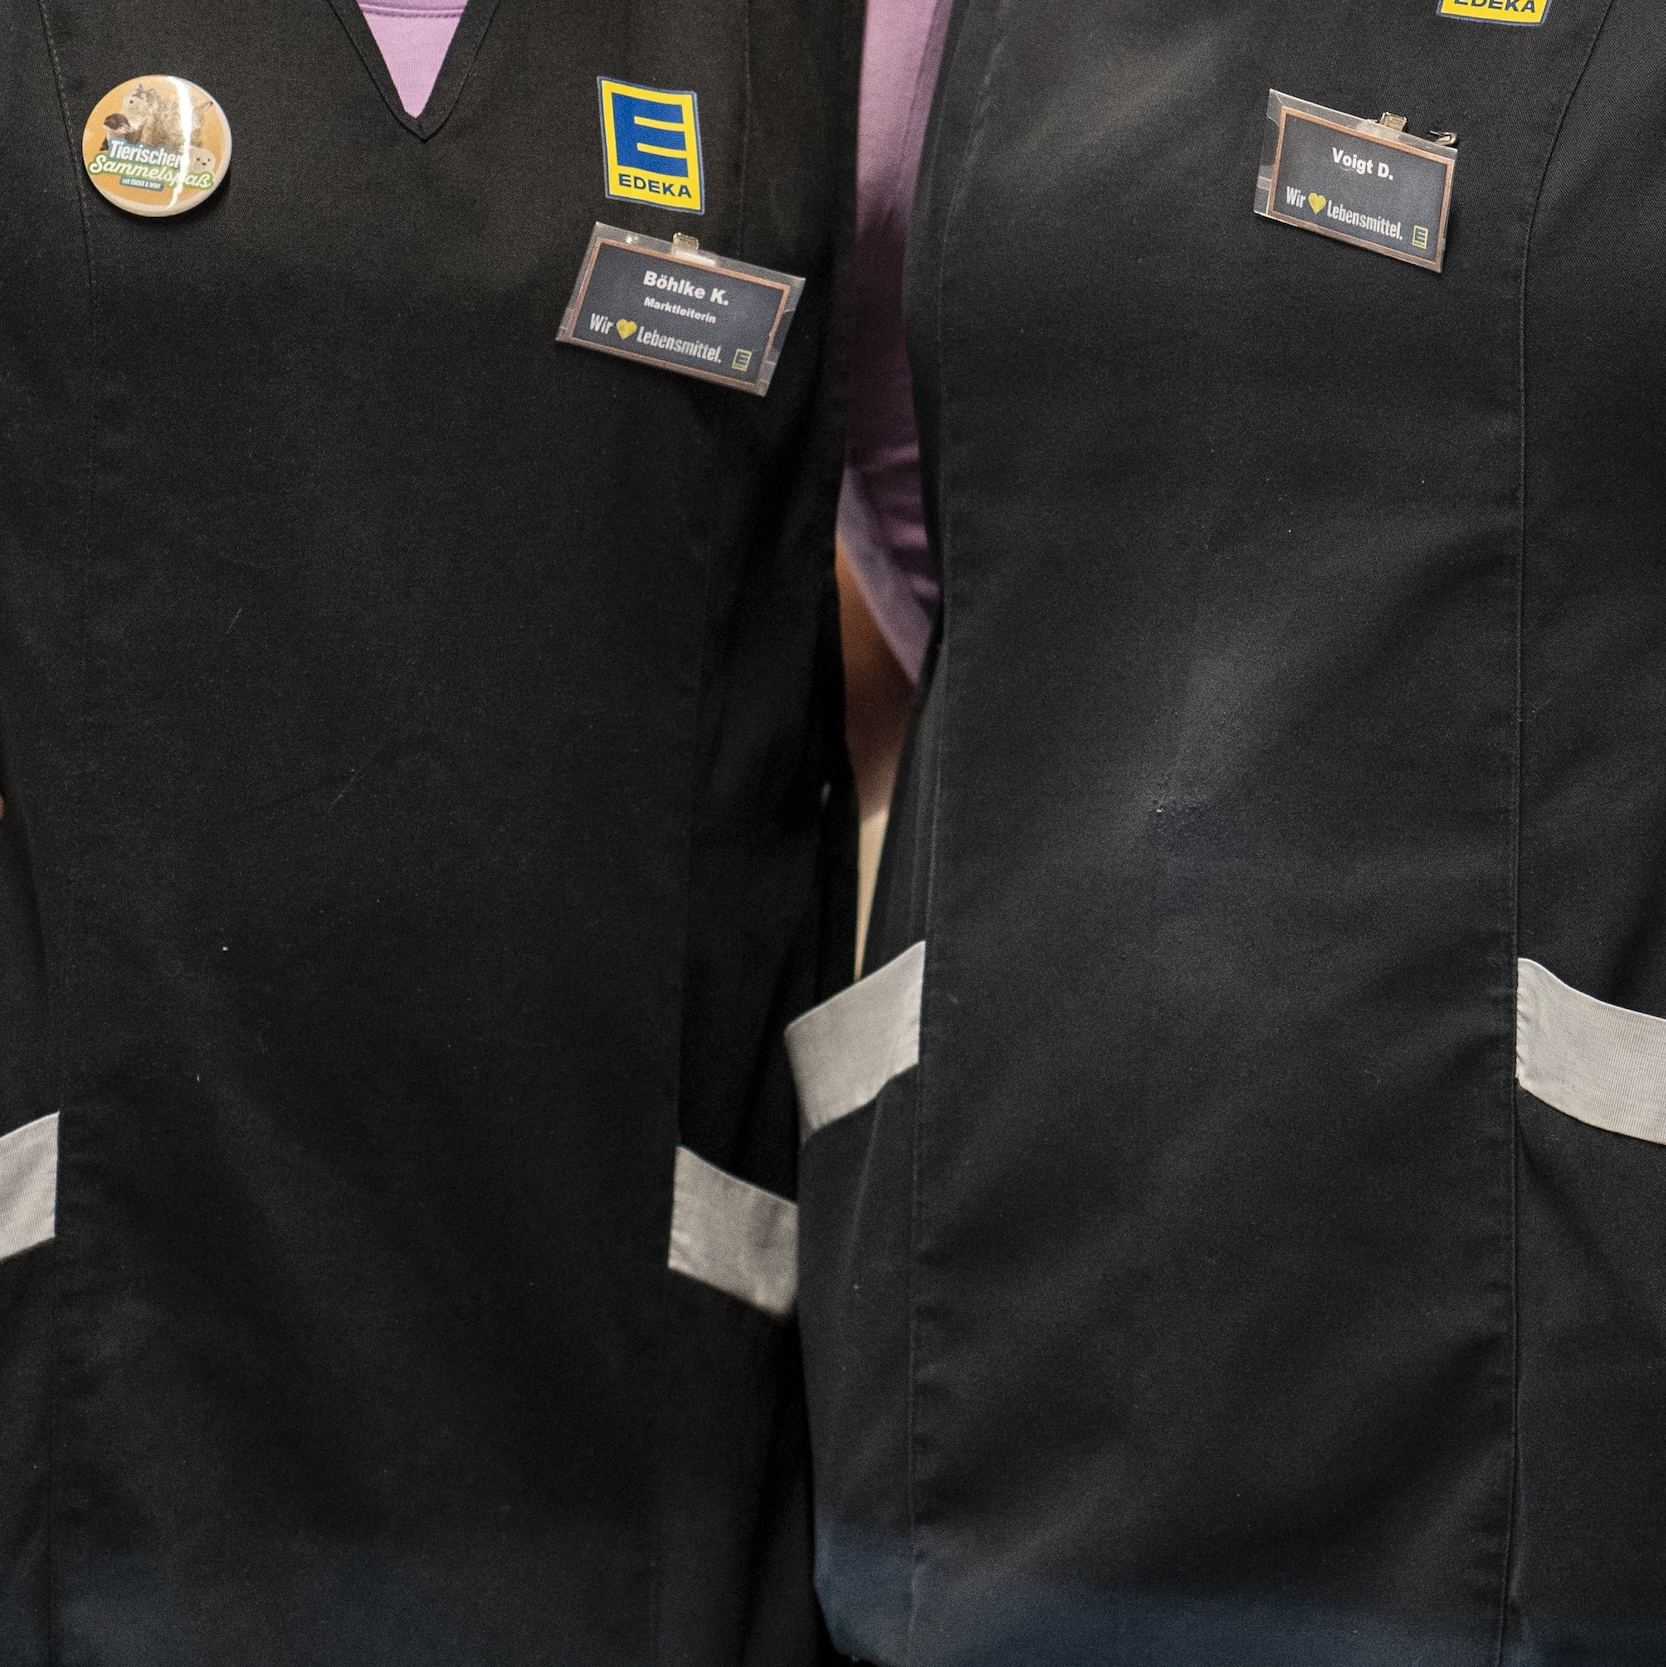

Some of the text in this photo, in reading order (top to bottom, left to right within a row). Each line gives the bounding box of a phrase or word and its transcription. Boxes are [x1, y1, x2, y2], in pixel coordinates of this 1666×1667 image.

[109, 140, 183, 169] Tierischer
[1332, 147, 1394, 181] Voigt D.
[618, 174, 693, 199] EDEKA
[1286, 185, 1404, 241] Wir Lebensmittel.
[643, 270, 730, 306] Böhlke K.
[644, 296, 717, 325] Marktleiterin
[589, 312, 723, 364] Wir Lebensmittel.
